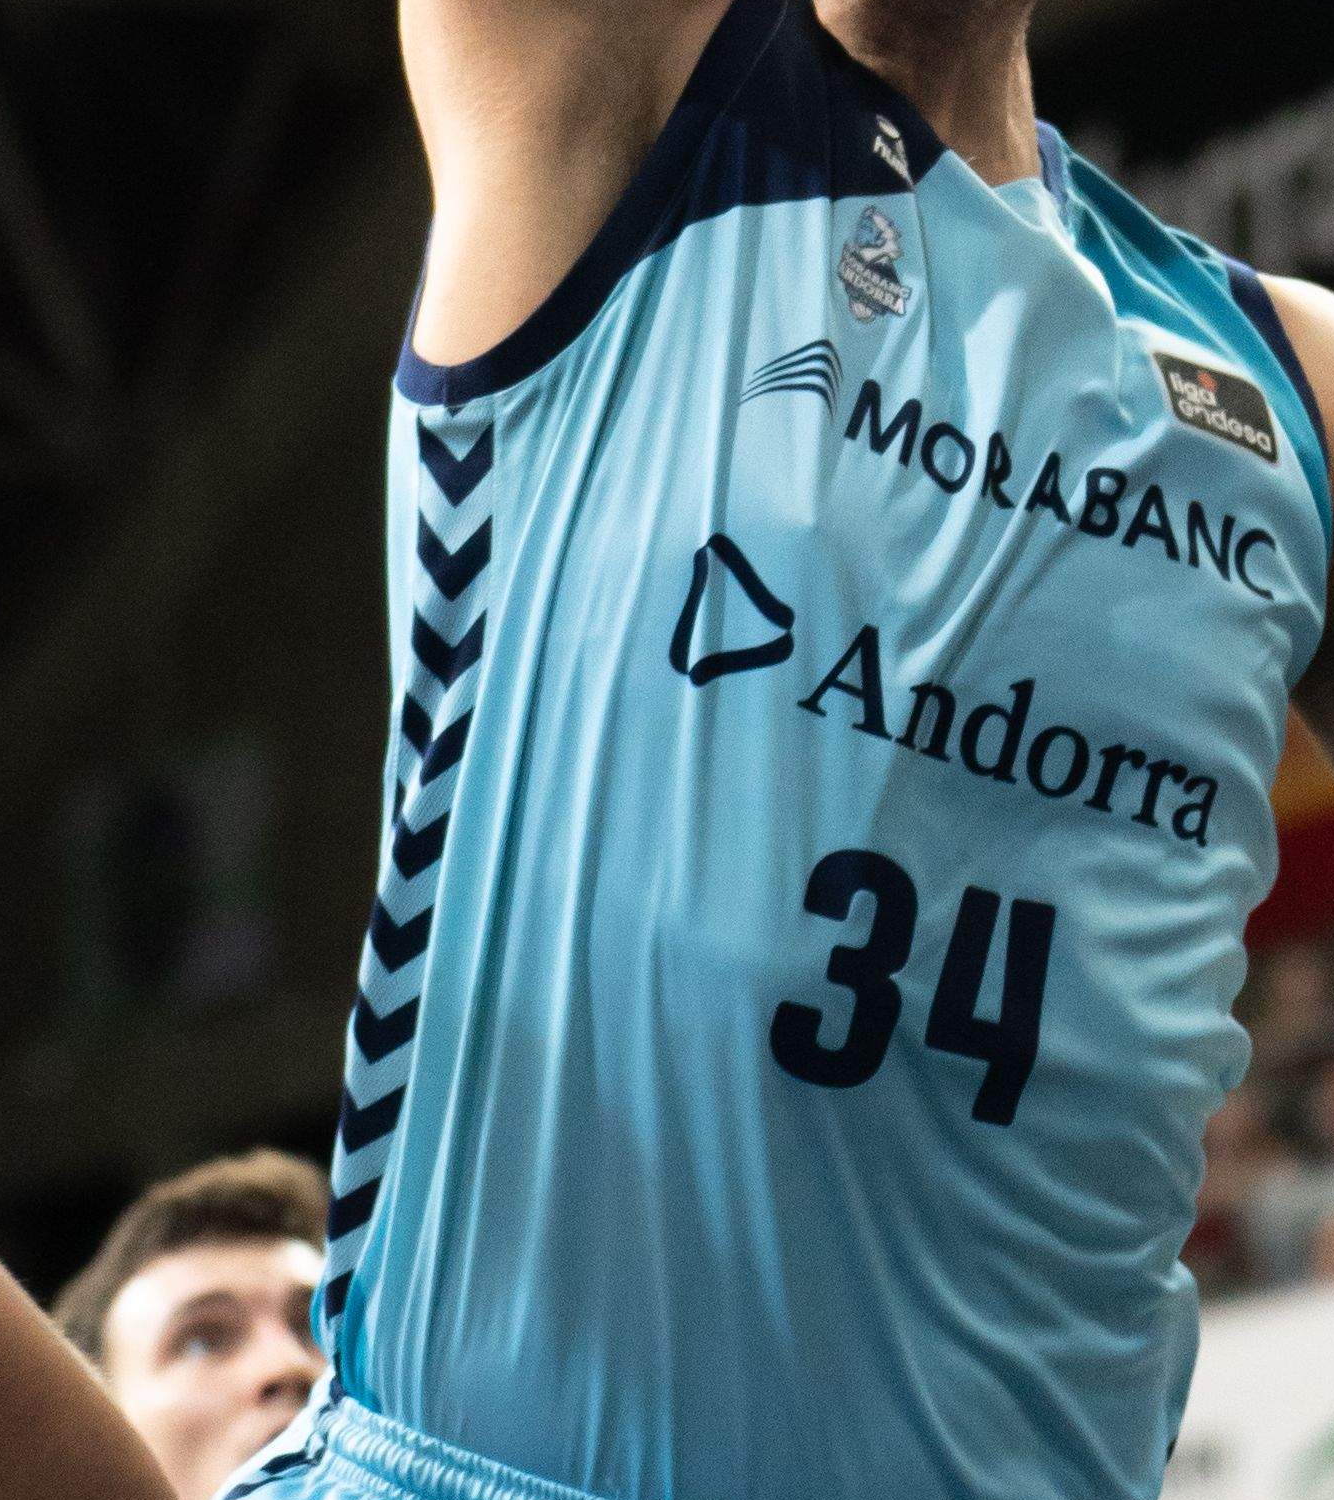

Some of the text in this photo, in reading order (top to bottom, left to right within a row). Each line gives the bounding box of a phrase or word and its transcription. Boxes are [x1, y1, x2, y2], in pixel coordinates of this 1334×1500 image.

[844, 378, 1277, 601] MORABANC
[1170, 371, 1217, 407] liga
[1177, 399, 1273, 453] endesa
[797, 623, 1220, 848] Andorra
[770, 848, 1056, 1127] 34
